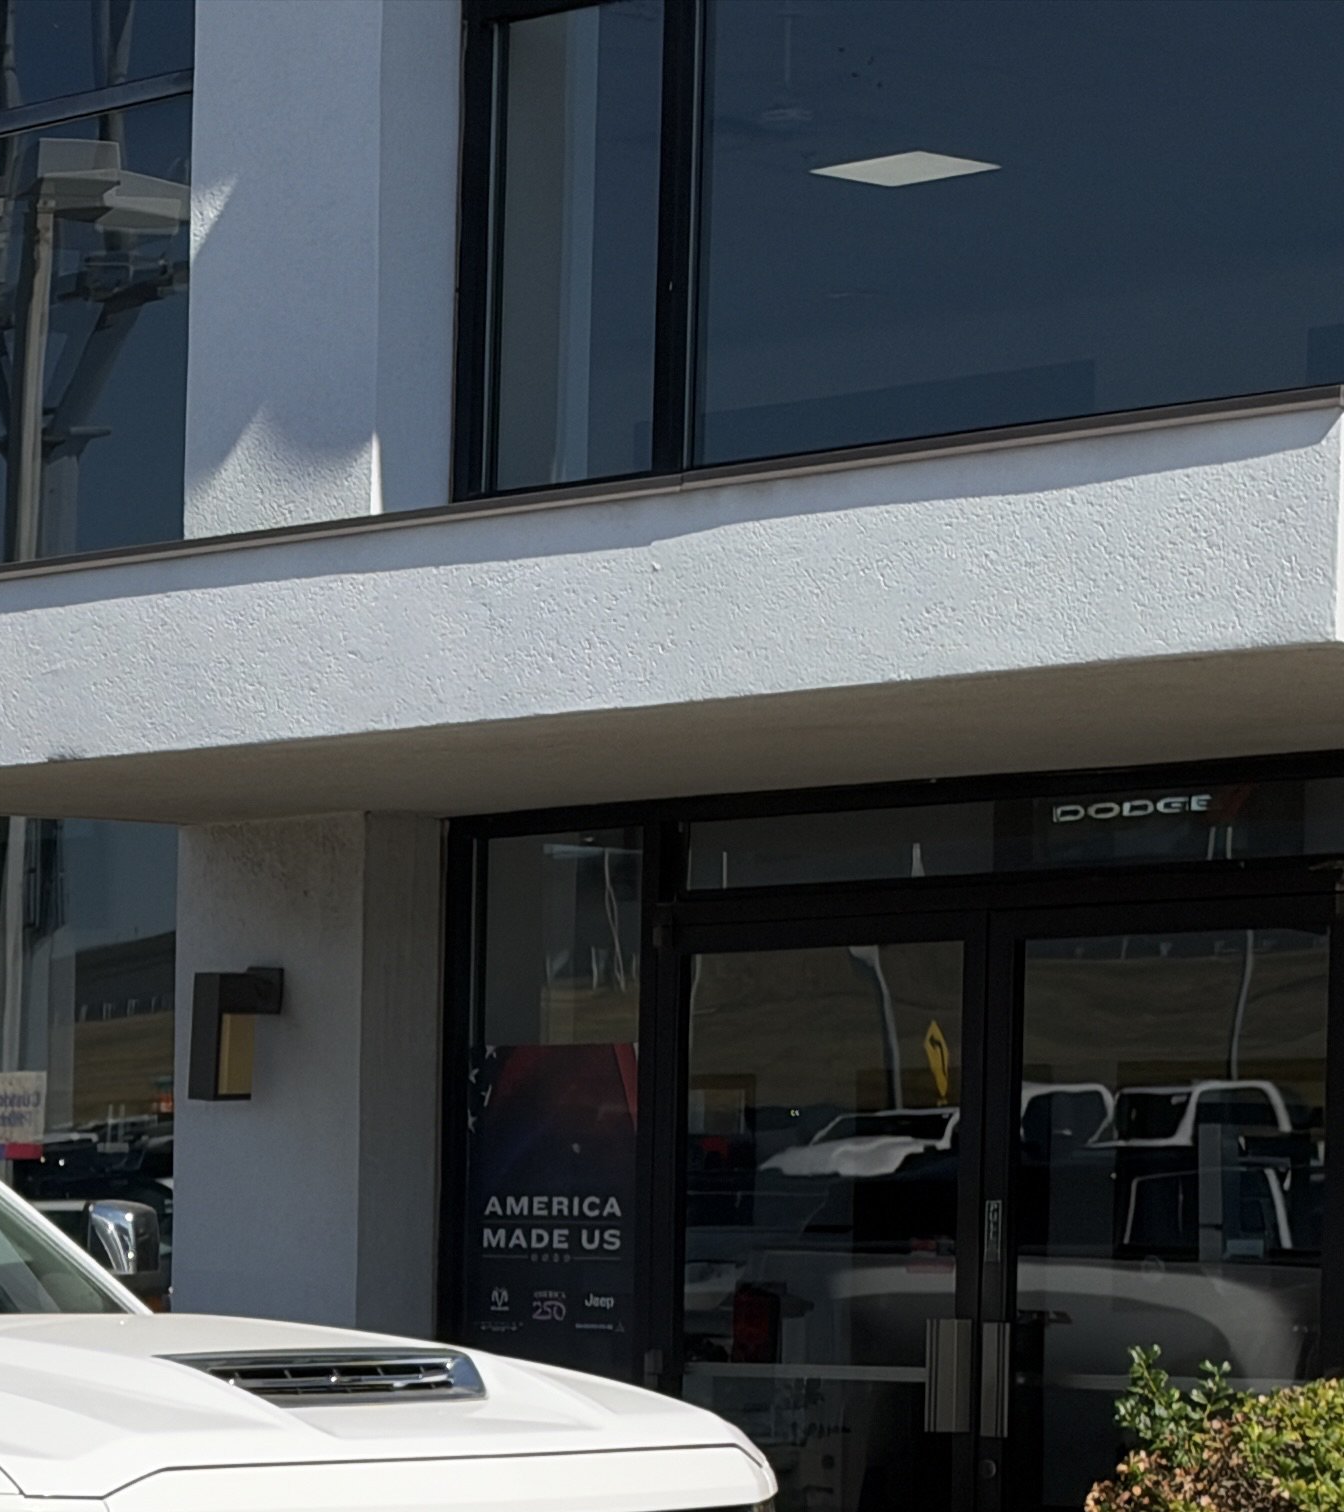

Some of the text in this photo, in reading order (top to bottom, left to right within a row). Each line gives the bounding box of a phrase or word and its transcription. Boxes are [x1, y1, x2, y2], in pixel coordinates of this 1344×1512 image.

[1052, 794, 1212, 823] DODGE
[483, 1195, 622, 1217] AMERICA
[482, 1227, 622, 1251] MADE US
[531, 1300, 567, 1321] 250
[584, 1293, 616, 1311] Jeep
